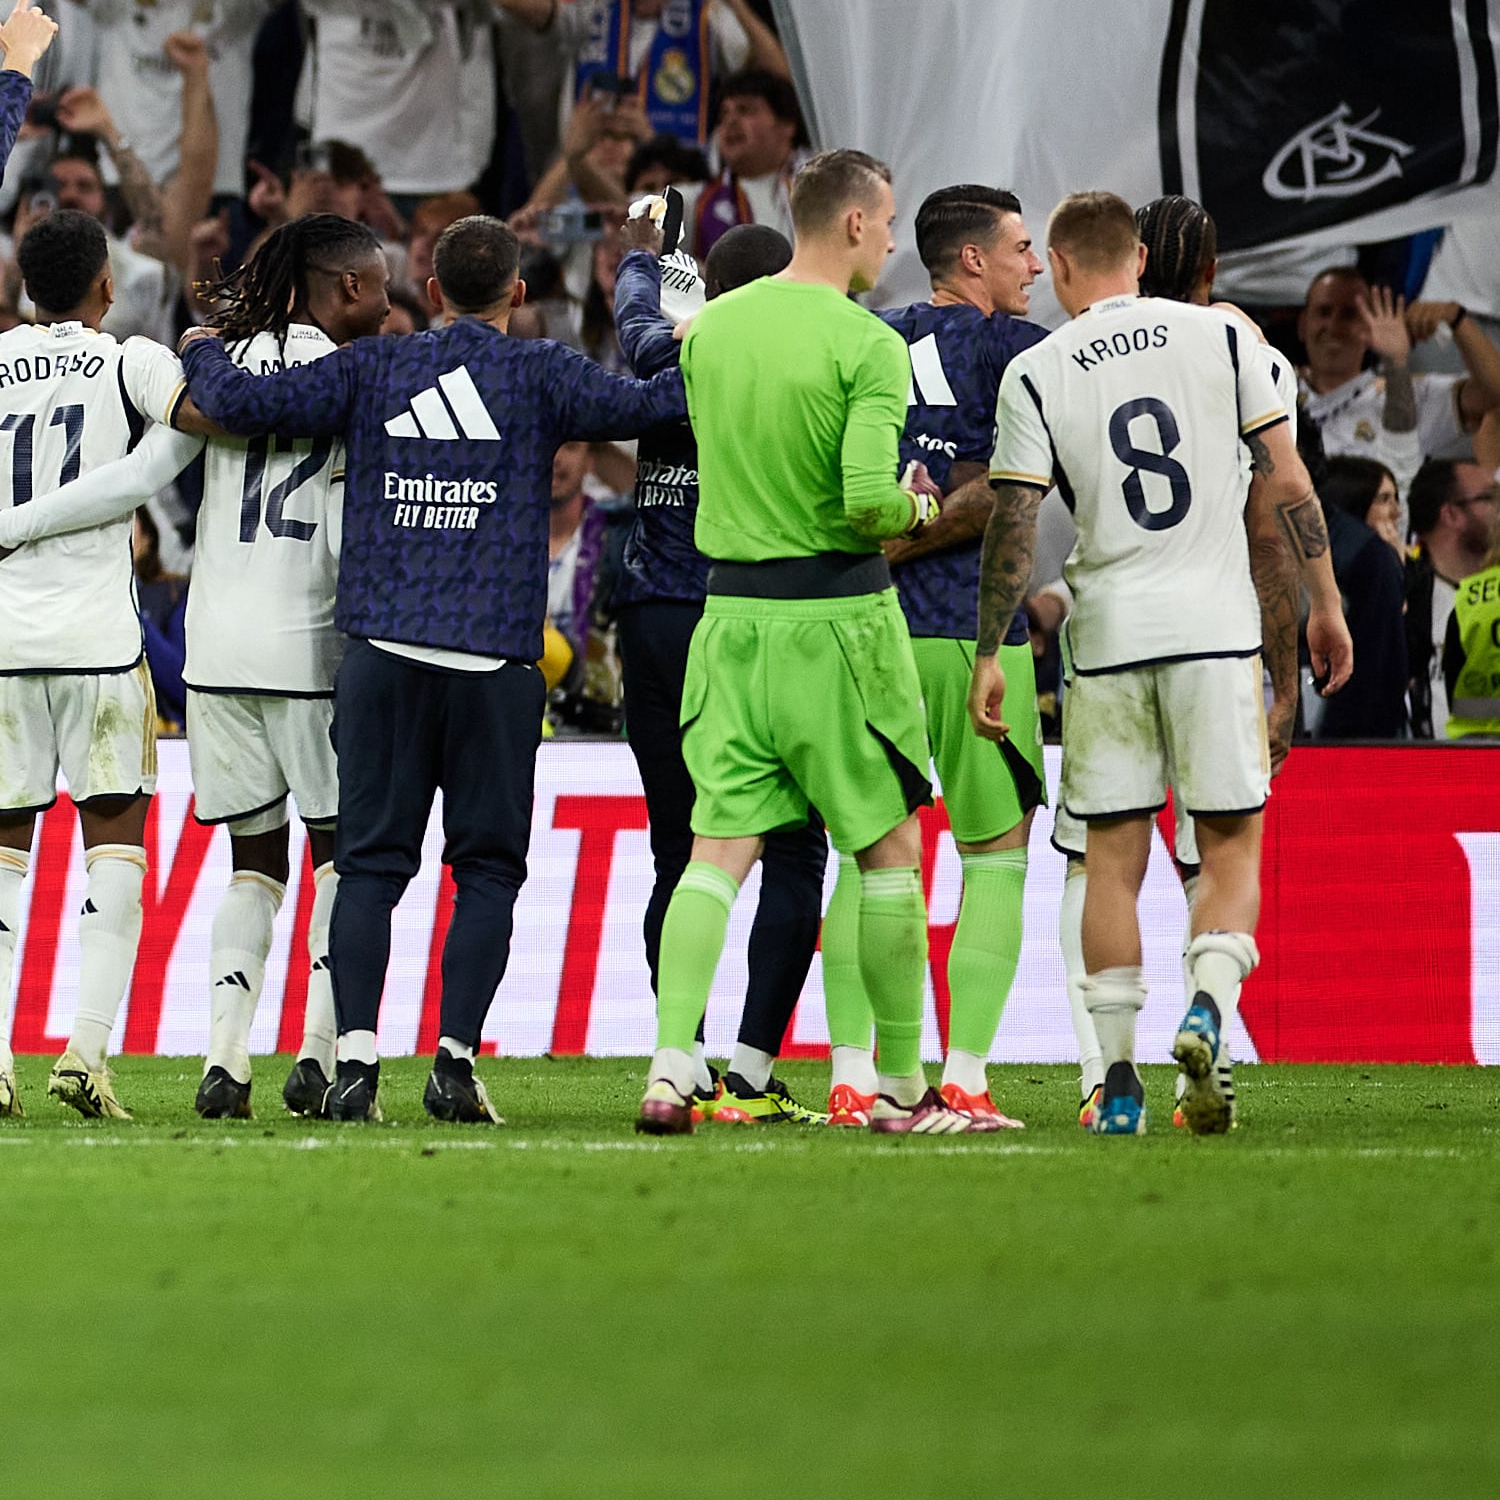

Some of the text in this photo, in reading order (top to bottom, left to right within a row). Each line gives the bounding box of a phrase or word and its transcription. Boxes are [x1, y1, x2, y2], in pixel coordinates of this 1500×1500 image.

[1072, 325, 1168, 372] KROOS
[638, 457, 699, 486] mirates
[1108, 397, 1193, 532] 8
[239, 436, 334, 543] 12
[384, 471, 498, 504] Emirates
[393, 503, 480, 529] FLY BETTER
